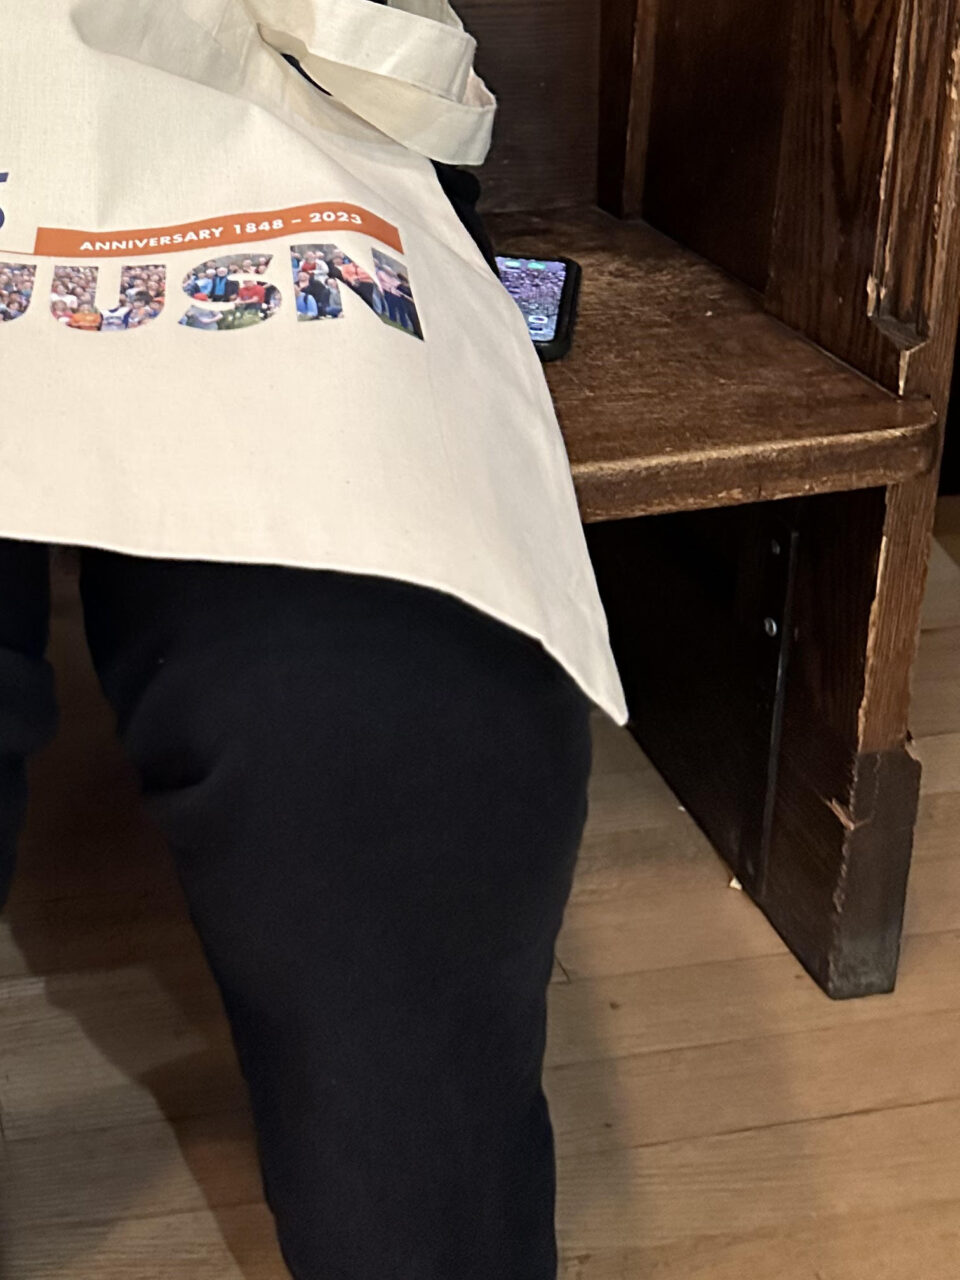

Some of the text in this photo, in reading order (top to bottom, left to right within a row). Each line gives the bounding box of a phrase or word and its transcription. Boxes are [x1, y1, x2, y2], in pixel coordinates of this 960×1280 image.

[79, 227, 224, 251] ANNIVERSARY
[234, 219, 284, 235] 1848
[309, 211, 363, 225] 2023
